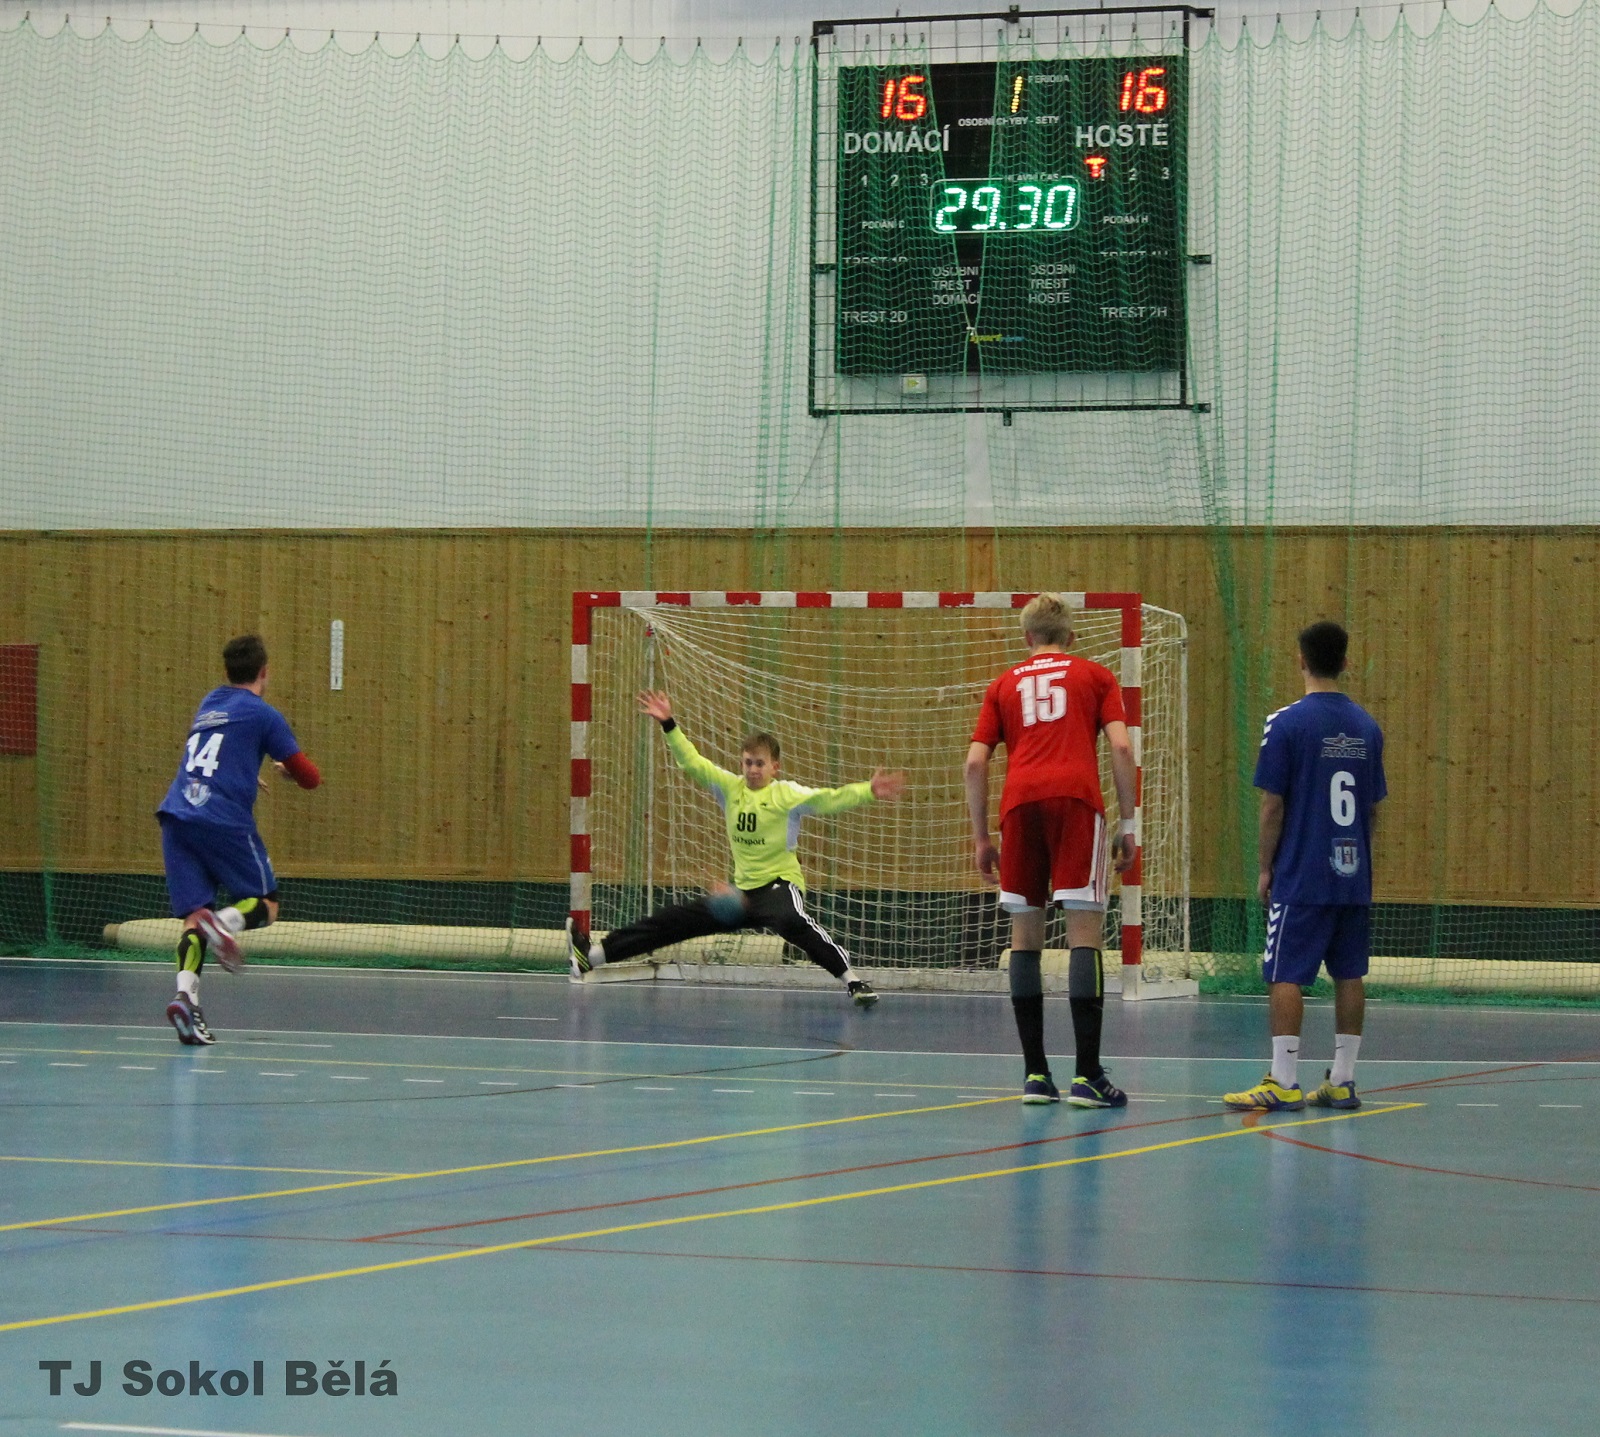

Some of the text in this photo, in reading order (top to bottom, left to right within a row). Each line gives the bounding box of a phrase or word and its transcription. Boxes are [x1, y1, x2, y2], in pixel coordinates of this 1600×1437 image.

[882, 75, 926, 120] 16
[1011, 75, 1023, 113] 1
[1120, 66, 1167, 114] 16
[1035, 115, 1060, 125] SETY
[1076, 119, 1169, 148] HOSTÉ
[844, 124, 950, 154] DOMÁCÍ
[861, 173, 929, 187] 1 2 3
[1128, 167, 1138, 181] 2
[1161, 167, 1170, 180] 3
[935, 185, 1076, 231] 29.30
[932, 279, 972, 291] TREST
[1031, 278, 1069, 289] TREST
[842, 310, 908, 323] TREST 2D
[1100, 306, 1168, 318] TREST 2H
[1016, 670, 1068, 727] 15
[185, 732, 224, 778] 14
[1330, 770, 1356, 827] 6
[736, 812, 757, 833] 99
